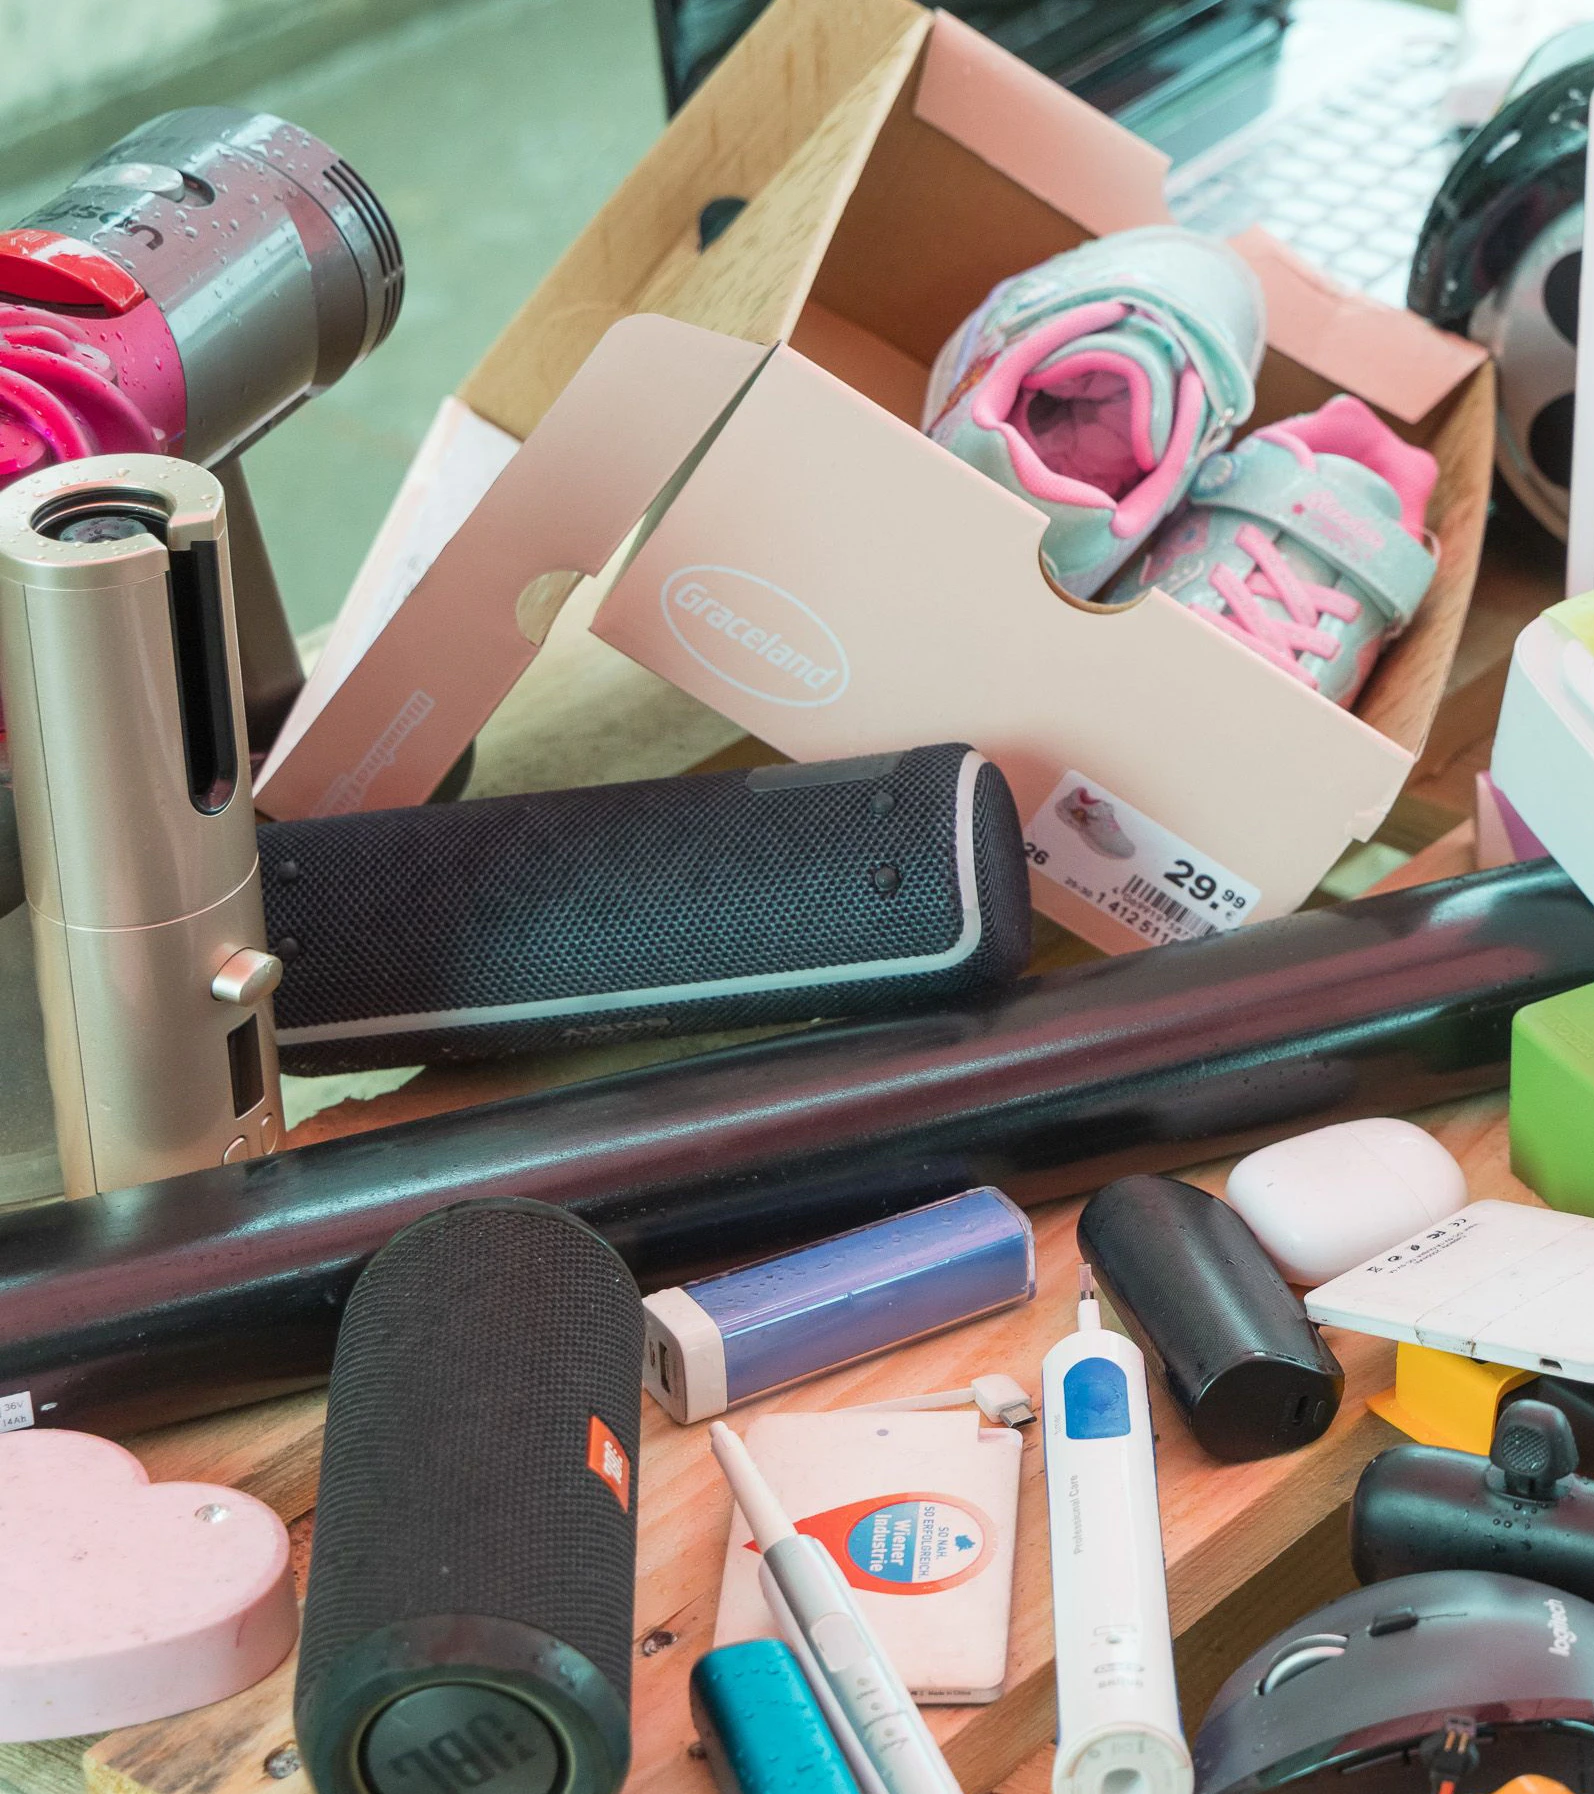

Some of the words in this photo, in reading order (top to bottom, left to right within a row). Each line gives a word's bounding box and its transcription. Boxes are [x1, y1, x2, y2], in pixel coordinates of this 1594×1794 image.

[674, 582, 838, 690] Graceland
[1024, 842, 1050, 866] 26
[4, 1401, 24, 1412] 36V
[1068, 1474, 1080, 1498] Care
[923, 1506, 935, 1517] SO
[1069, 1499, 1084, 1556] Professional
[869, 1513, 893, 1573] Industrie
[890, 1519, 912, 1566] Wiener
[919, 1519, 935, 1579] ERFOLGREICH.
[936, 1538, 949, 1560] NAH.
[938, 1526, 950, 1538] SO
[1543, 1598, 1577, 1655] logitech
